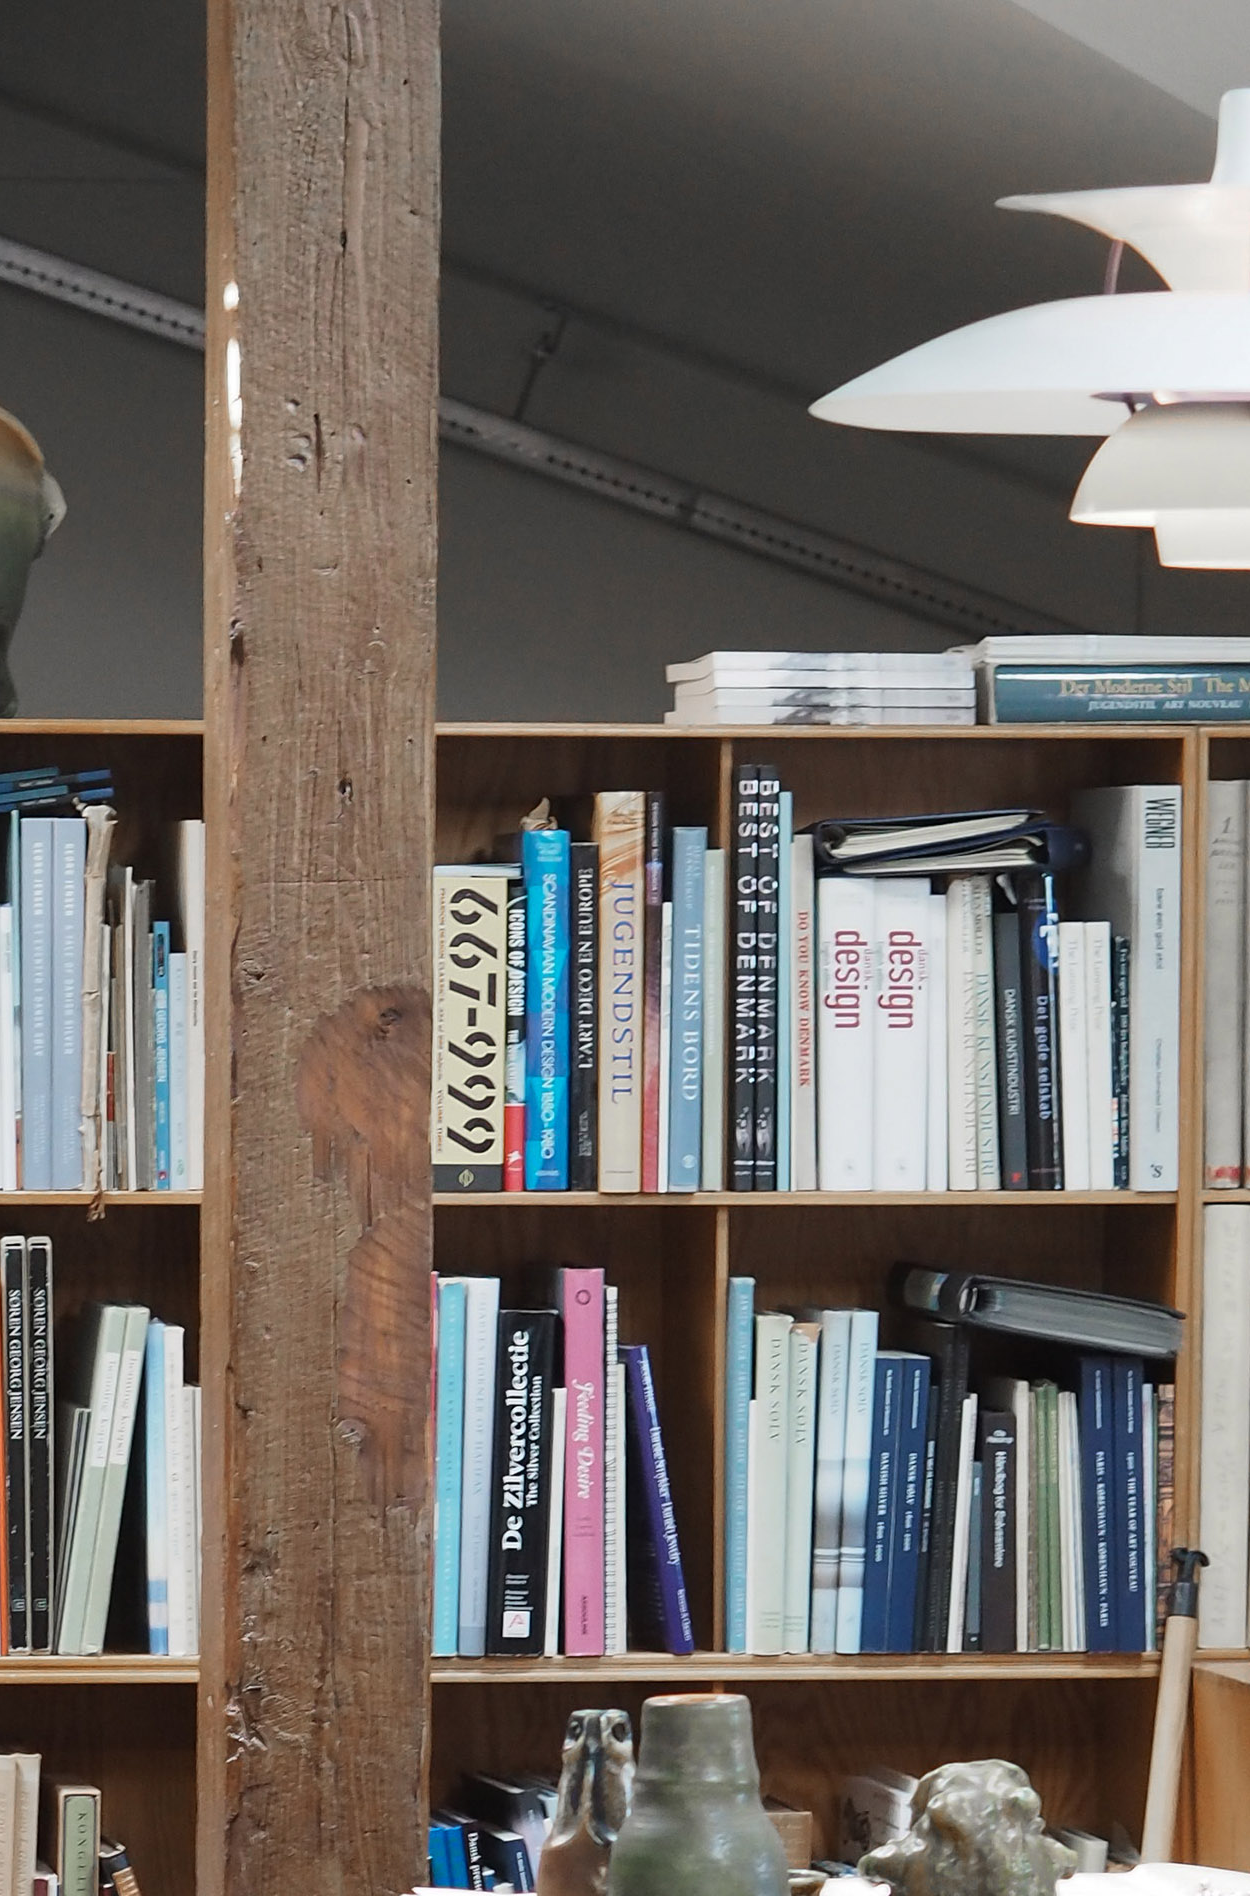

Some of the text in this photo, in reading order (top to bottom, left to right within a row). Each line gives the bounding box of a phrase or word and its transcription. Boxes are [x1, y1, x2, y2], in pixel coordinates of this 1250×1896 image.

[1094, 680, 1163, 695] Moderne
[1167, 679, 1191, 694] Stil
[1205, 678, 1235, 693] The
[1162, 700, 1184, 709] ART
[1145, 798, 1176, 849] WEGNER
[540, 873, 557, 974] SCANDINAVIAN
[578, 868, 593, 935] EUROPE
[735, 780, 757, 1085] BEST OF DENMARK
[756, 780, 780, 1085] BEST OF DENMARK
[507, 909, 525, 1016] ICONS OF DESIGN
[578, 941, 593, 964] EN
[609, 879, 634, 1105] JUGENDSTIL
[797, 911, 810, 1087] DO YOU KNOW DENMARK
[824, 930, 868, 1029] design
[863, 948, 874, 982] dansk
[878, 930, 922, 1029] design
[918, 949, 928, 983] dansk
[155, 1010, 168, 1082] GEORG JENSEN
[447, 888, 498, 1154] 667-999
[540, 977, 556, 1037] MODERN
[577, 1019, 594, 1069] L'ART
[681, 924, 701, 1100] TIDENS BORD
[1004, 988, 1019, 1116] DANSK KUNSTINDUSTRI
[540, 1040, 556, 1089] DESIGN
[975, 973, 994, 1177] DANSK KUNSTINDUSTRI
[1033, 995, 1052, 1120] Det gode selskab
[8, 1339, 23, 1388] GEORG
[7, 1389, 24, 1440] JENSEN
[501, 1330, 530, 1550] De Zilvercollectie
[526, 1375, 544, 1507] The Silver Collection
[572, 1379, 596, 1500] Feeding Desire
[877, 1452, 890, 1517] DANISH SILVER
[468, 1832, 481, 1863] Dansk
